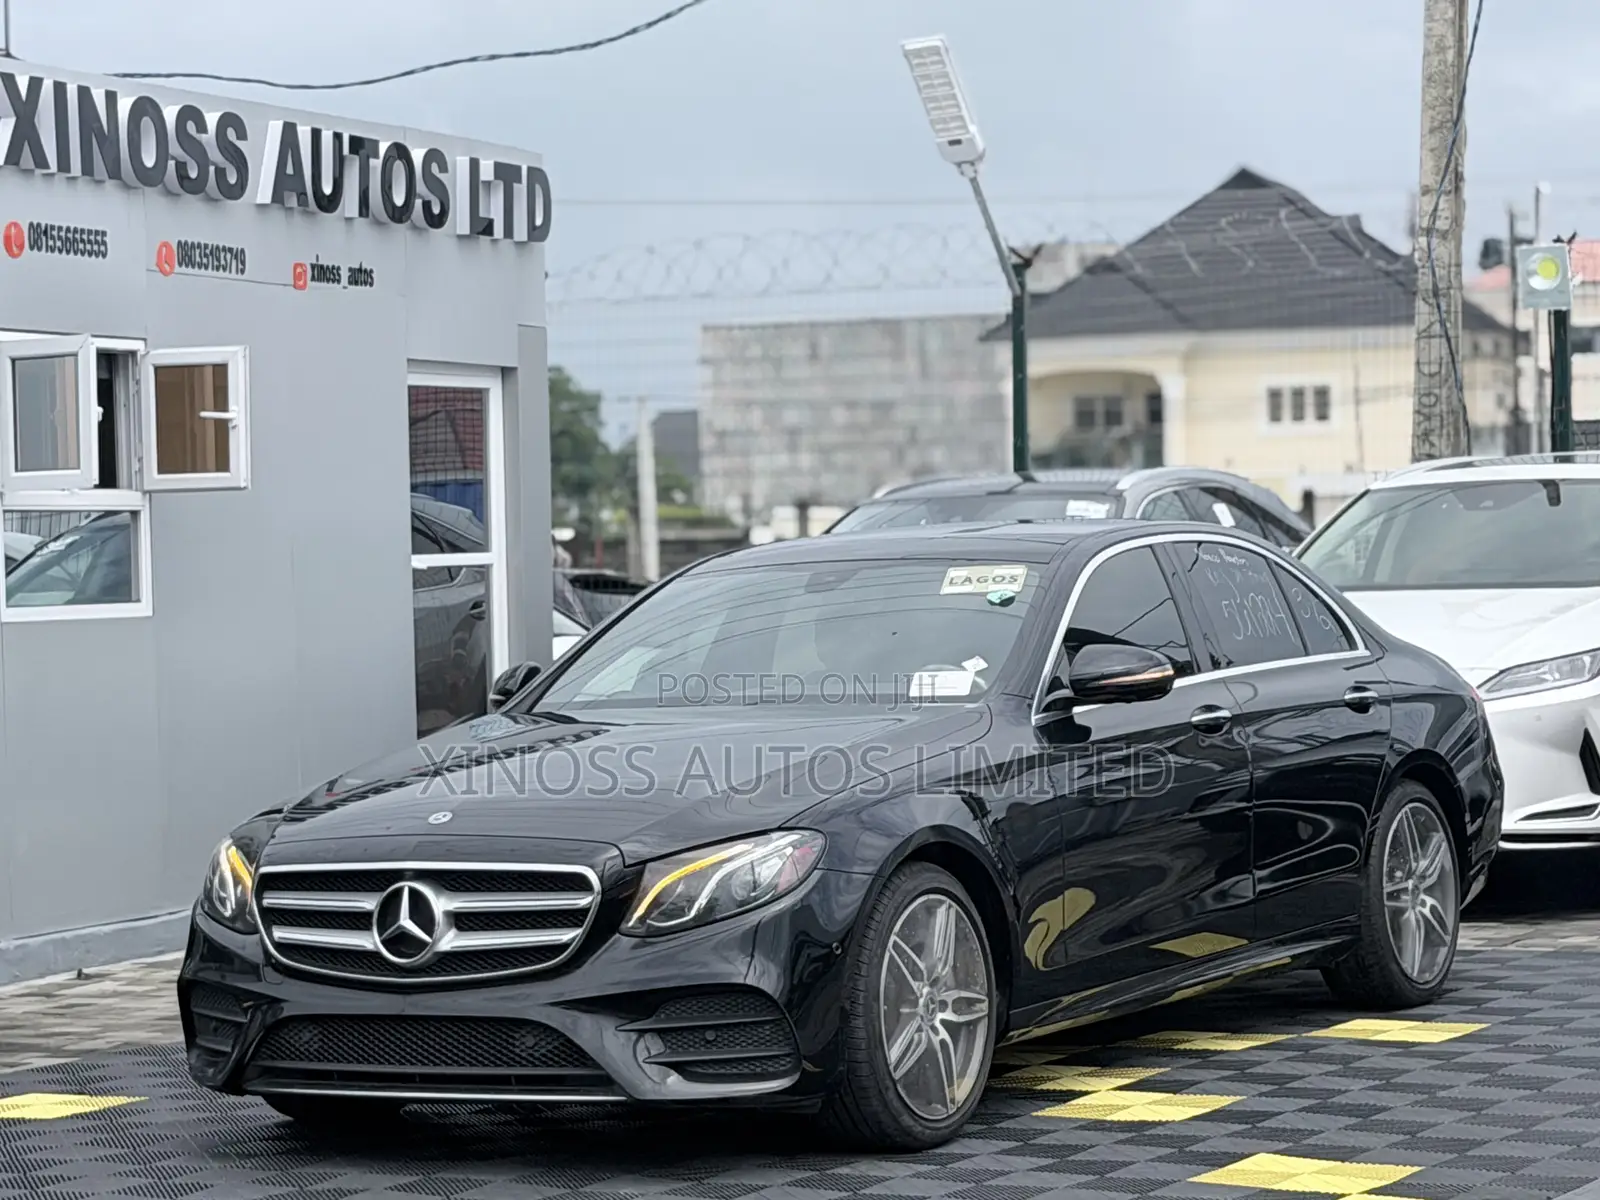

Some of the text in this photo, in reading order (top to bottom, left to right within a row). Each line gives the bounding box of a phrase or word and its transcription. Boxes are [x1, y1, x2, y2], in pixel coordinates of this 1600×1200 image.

[0, 71, 552, 242] XINOSS AUTOS LTD
[28, 221, 108, 259] 08155665555
[176, 239, 247, 275] 08035193719
[948, 574, 1020, 586] LAGOS
